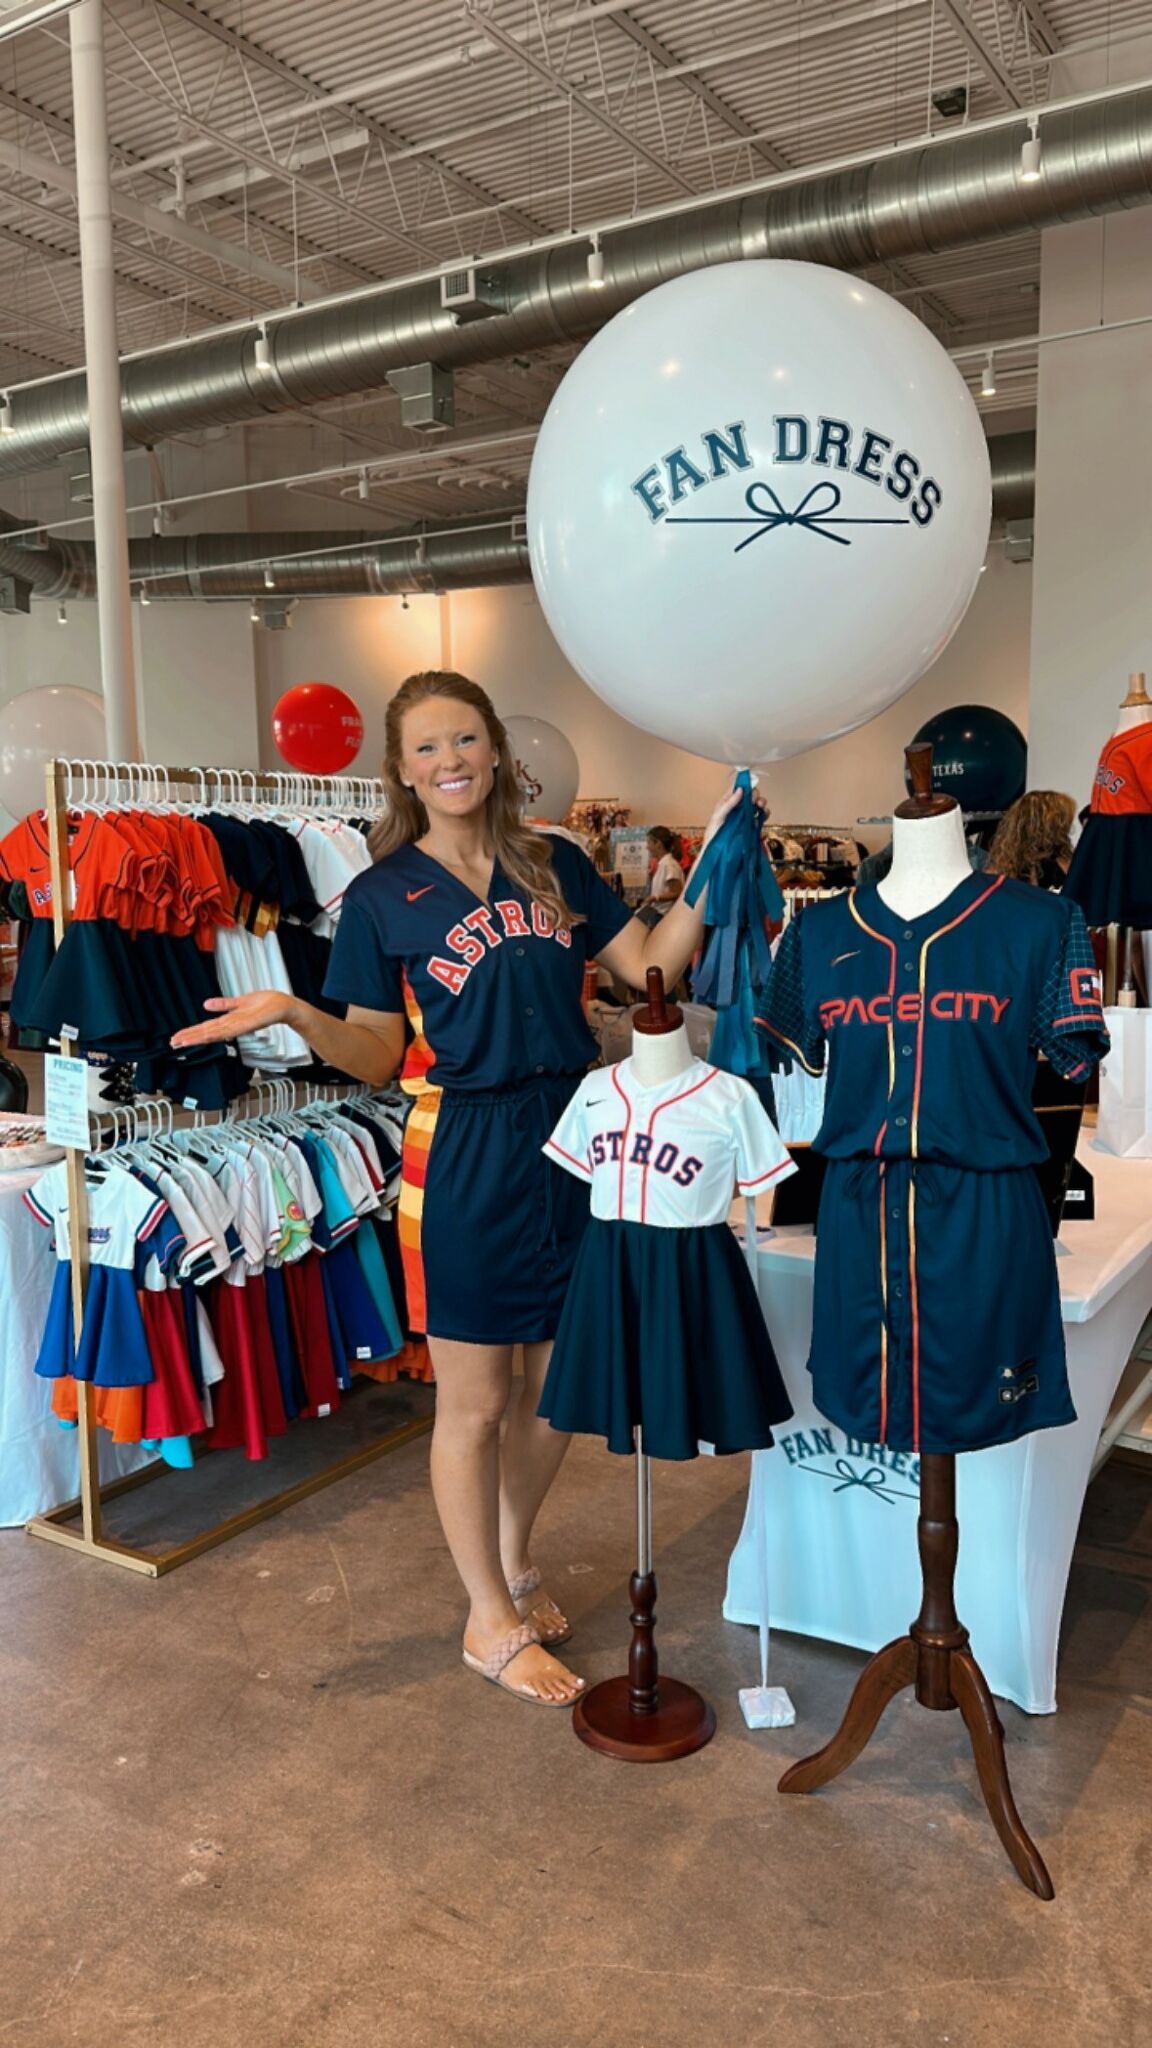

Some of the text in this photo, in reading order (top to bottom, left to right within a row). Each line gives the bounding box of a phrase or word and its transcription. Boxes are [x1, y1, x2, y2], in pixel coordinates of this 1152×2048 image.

[630, 414, 943, 528] FAN DRESS
[932, 761, 964, 777] TEXAS
[929, 990, 1010, 1025] CITY
[587, 1130, 704, 1187] STROS
[779, 1427, 920, 1487] FAN DRES
